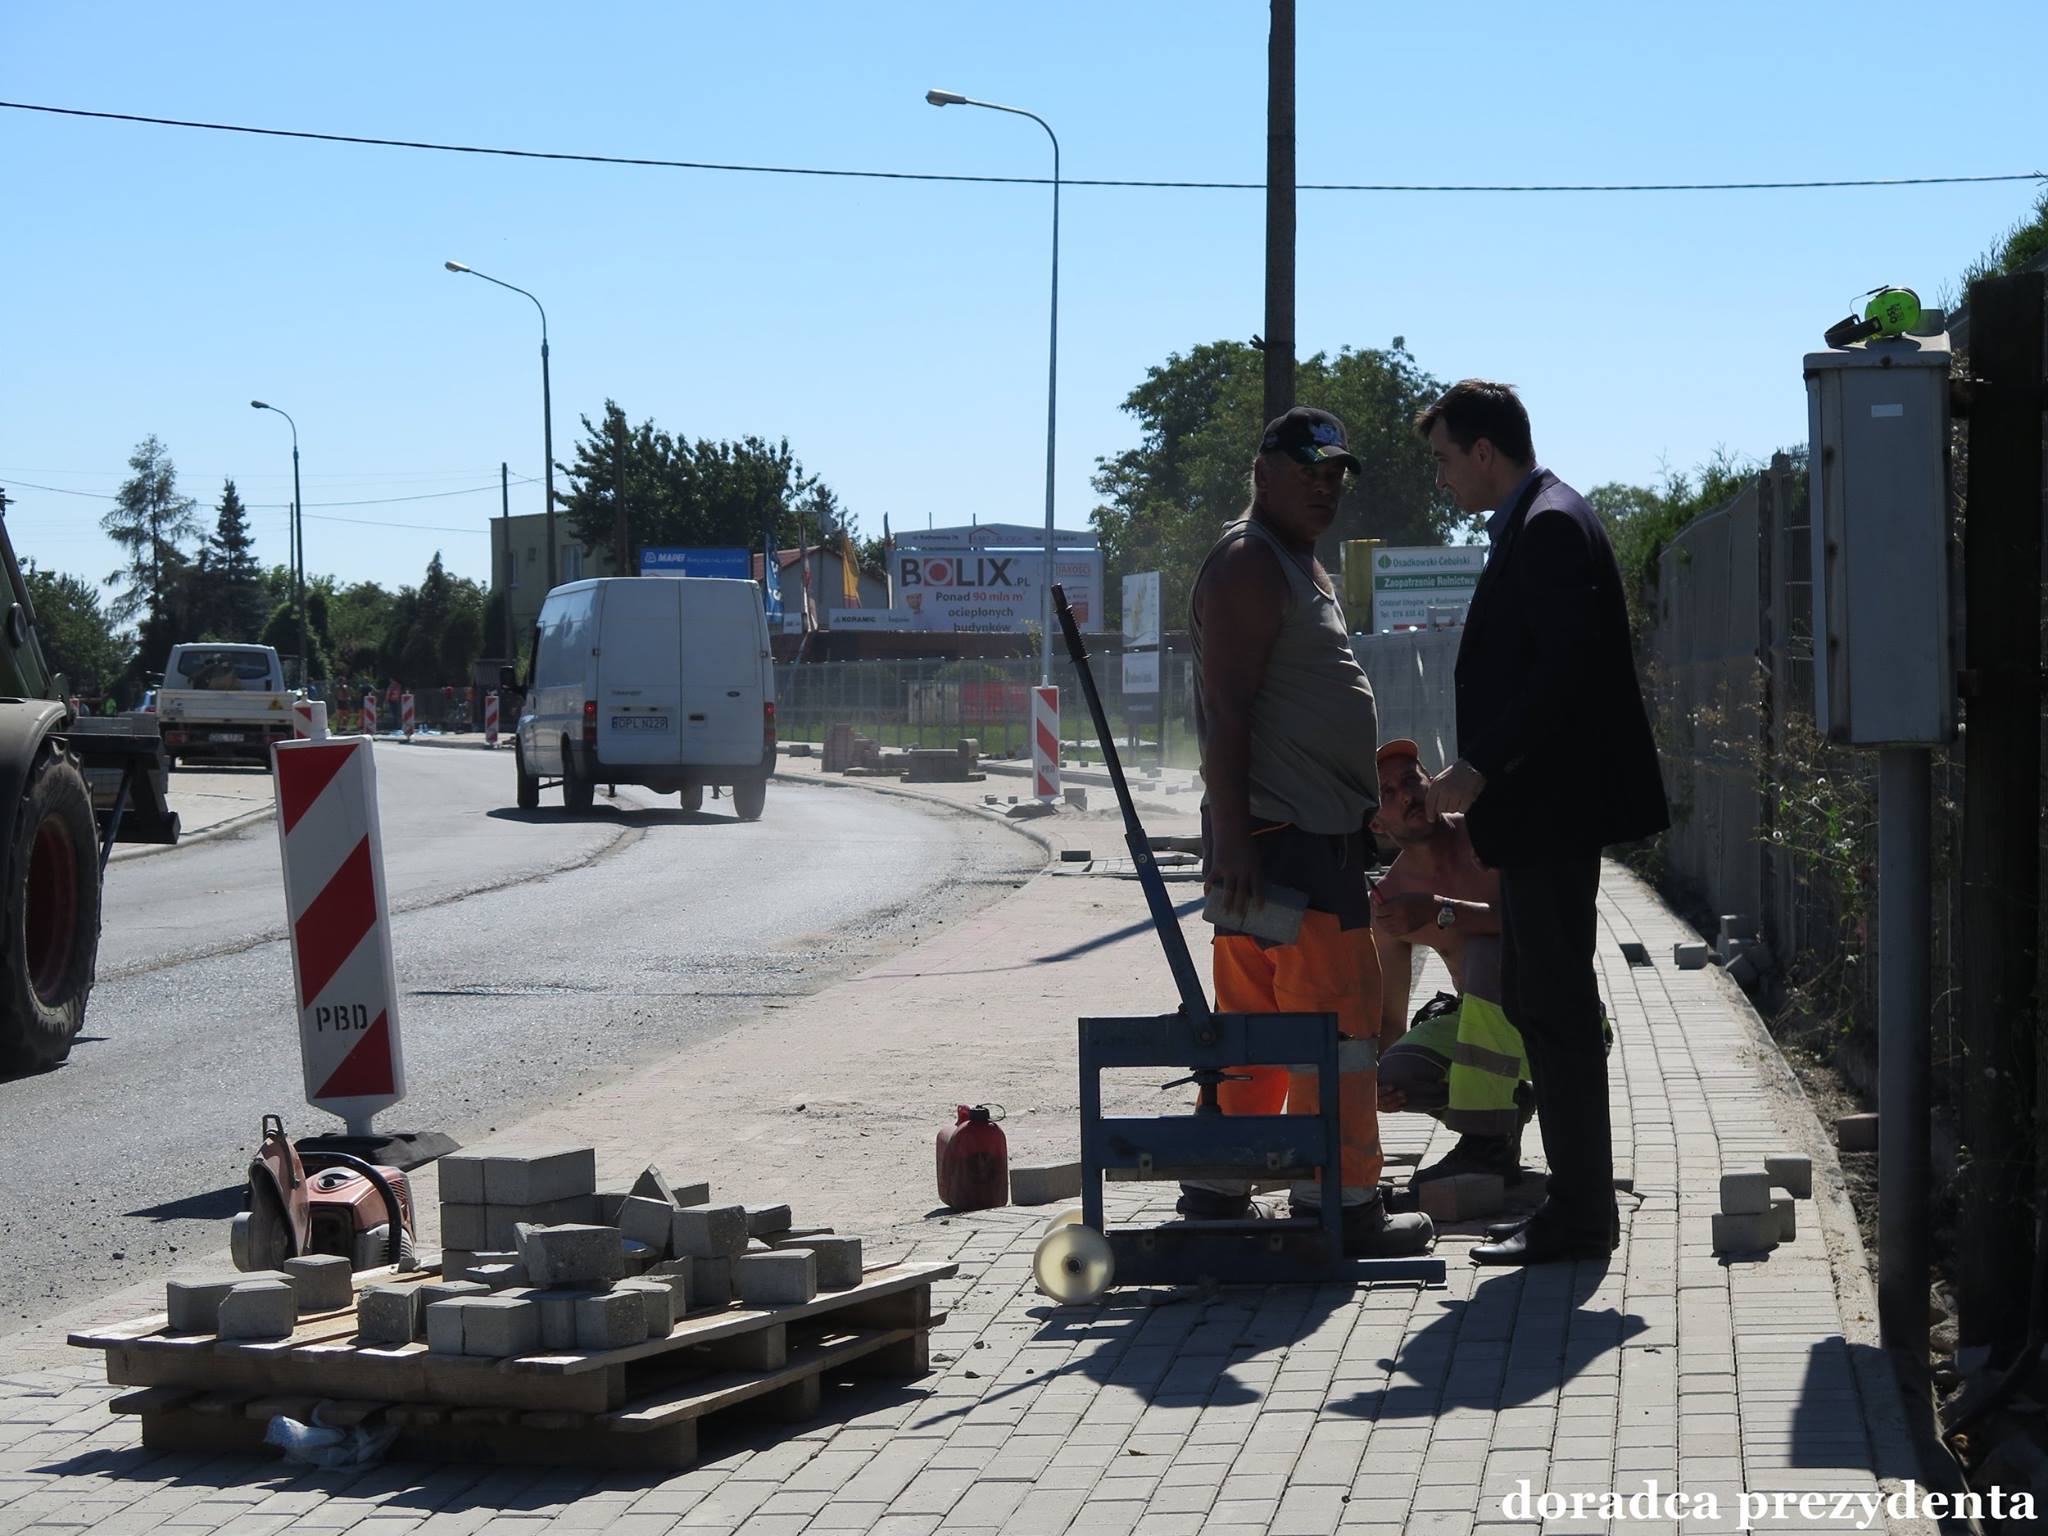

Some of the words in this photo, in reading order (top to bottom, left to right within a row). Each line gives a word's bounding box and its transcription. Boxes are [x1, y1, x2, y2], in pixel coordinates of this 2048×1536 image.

[657, 553, 686, 562] MAPEI
[1383, 576, 1436, 588] Zaopatrzenie
[1436, 575, 1476, 586] Rolnictwa
[935, 591, 971, 602] Ponad
[972, 591, 987, 602] 90
[988, 591, 1010, 602] mln
[947, 607, 1014, 620] ocieplonych
[953, 622, 1012, 633] budynków
[315, 1003, 368, 1032] PBD
